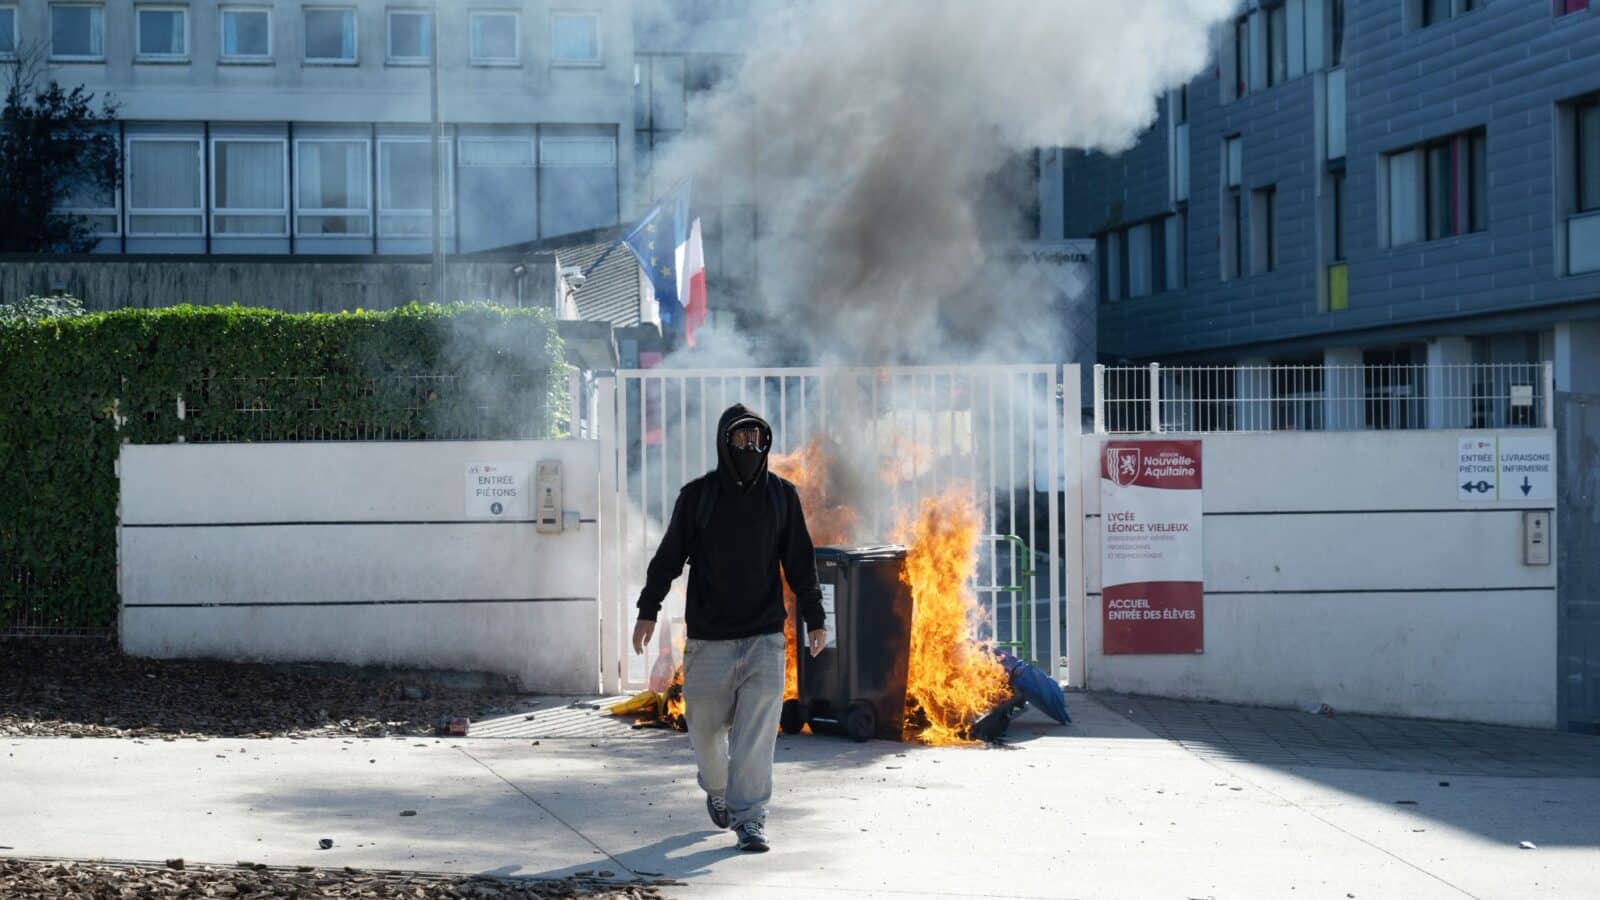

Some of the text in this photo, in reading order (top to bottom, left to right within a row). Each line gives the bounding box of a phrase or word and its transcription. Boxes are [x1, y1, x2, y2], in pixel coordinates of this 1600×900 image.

[1145, 456, 1196, 466] Nouvelle-
[1501, 454, 1551, 462] LIVRAISONS
[1145, 467, 1196, 479] Aquitaine
[1459, 464, 1495, 473] PIÉTONS
[1502, 464, 1549, 473] INFIRMERIE
[479, 474, 513, 485] ENTRÉE
[476, 487, 517, 497] PIÉTONS
[1108, 511, 1136, 522] LYCÉE
[1108, 522, 1189, 533] LÉONCE VIELJEUX
[1109, 600, 1150, 609] ACCUEIL
[1109, 608, 1196, 620] ENTRÉE DES ÉLÈVES
